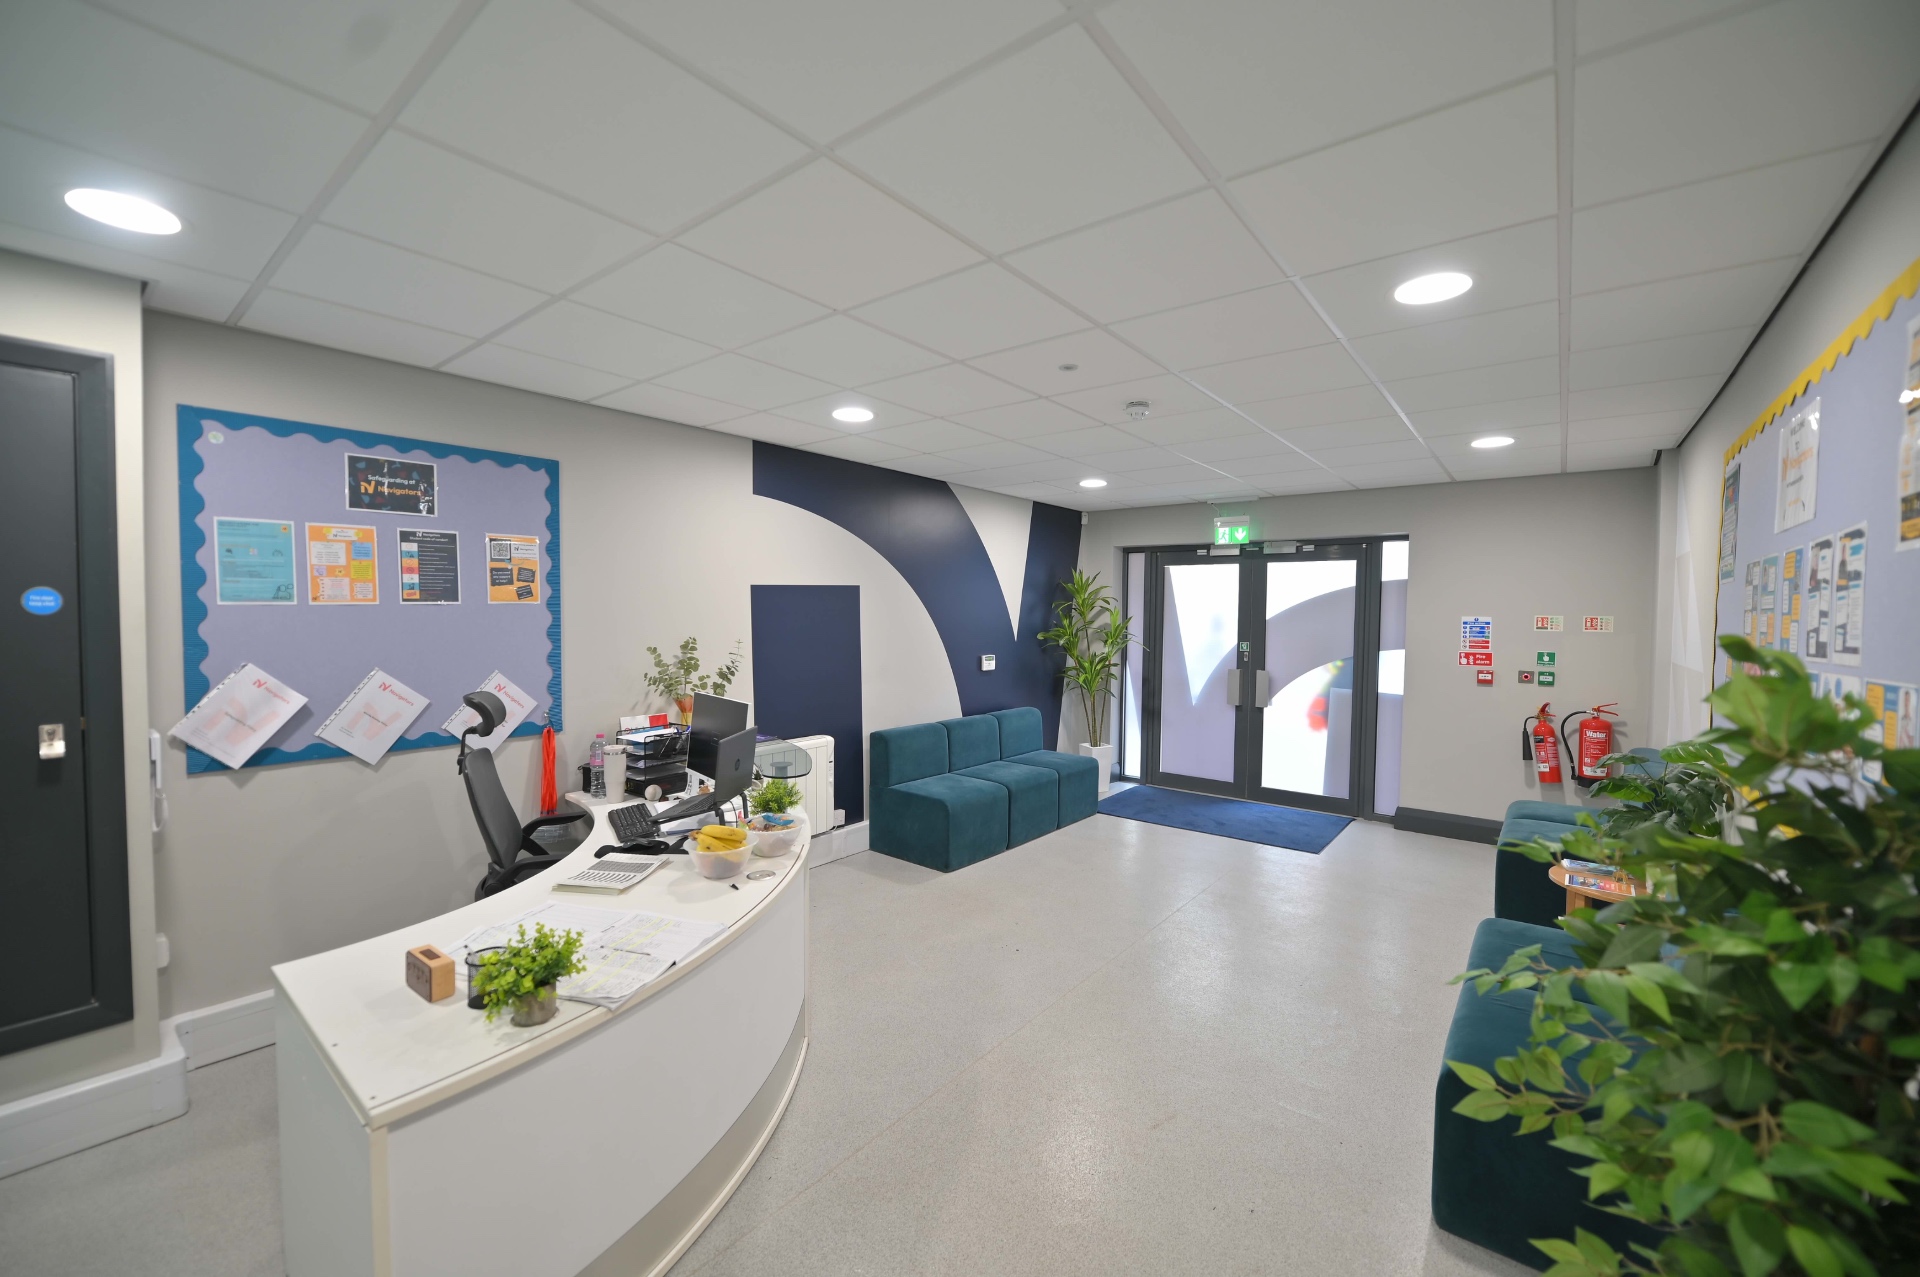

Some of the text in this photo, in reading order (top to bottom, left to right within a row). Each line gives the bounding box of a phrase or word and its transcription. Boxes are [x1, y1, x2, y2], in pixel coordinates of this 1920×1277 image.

[367, 474, 408, 485] Safeguarding
[377, 485, 421, 497] Navigators
[389, 688, 414, 706] Navigators
[503, 690, 525, 709] Navigators
[1585, 730, 1606, 738] Water
